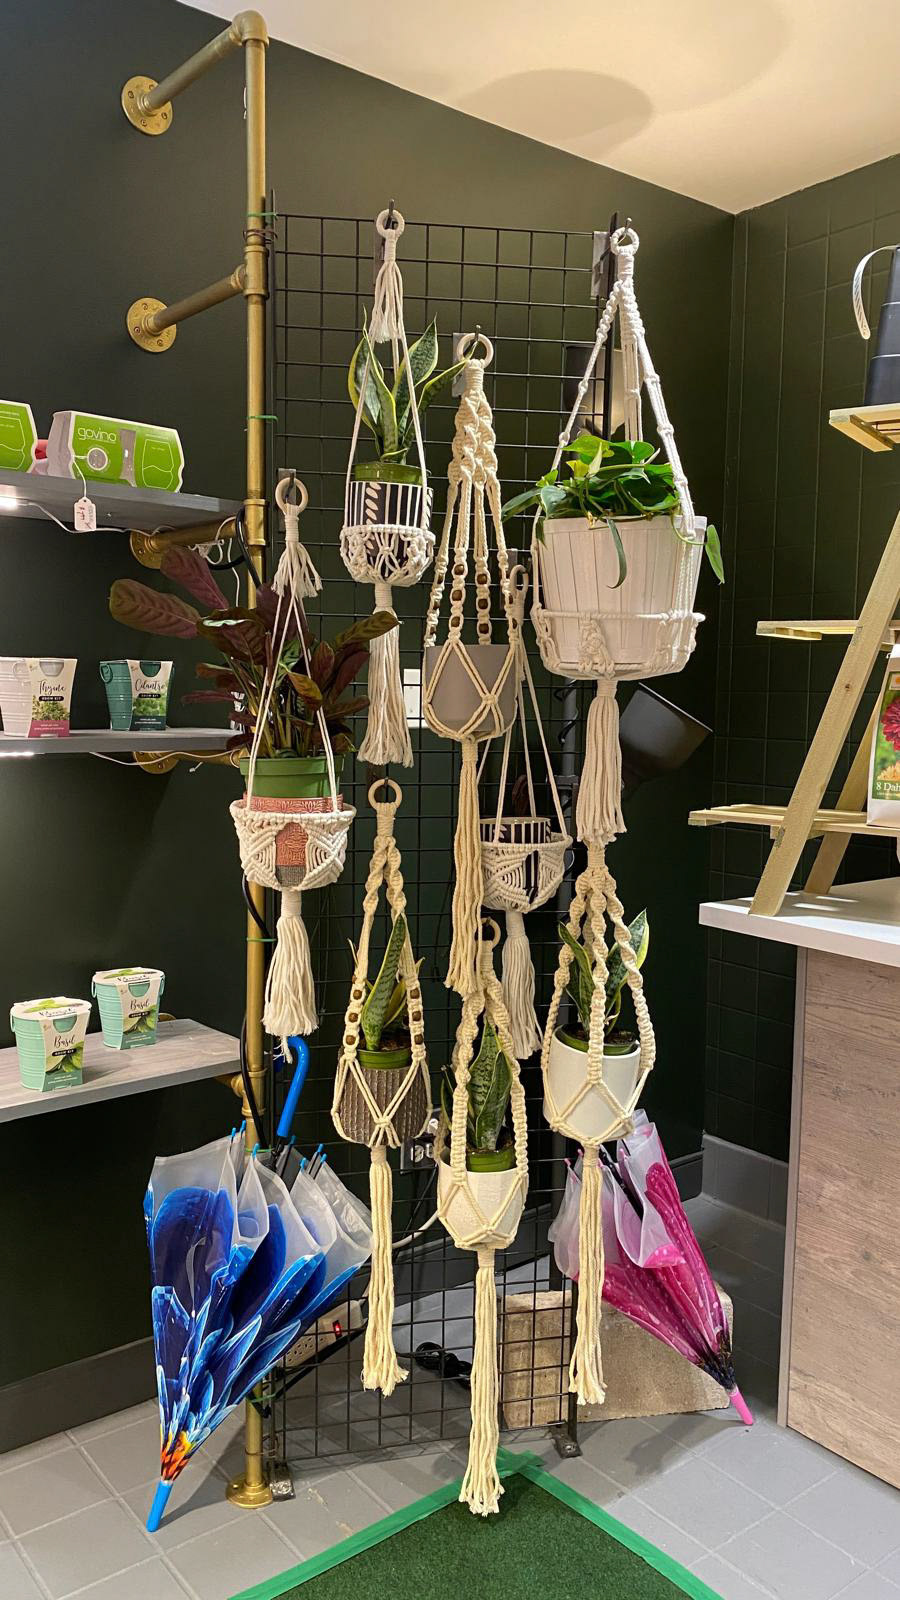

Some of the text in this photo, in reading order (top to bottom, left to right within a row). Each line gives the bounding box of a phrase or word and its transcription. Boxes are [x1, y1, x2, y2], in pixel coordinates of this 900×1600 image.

[78, 427, 117, 441] govino
[37, 679, 66, 696] Thyme
[135, 679, 165, 691] Cilantro
[876, 781, 881, 791] 8
[130, 999, 150, 1011] Basil
[54, 1034, 75, 1048] Basil
